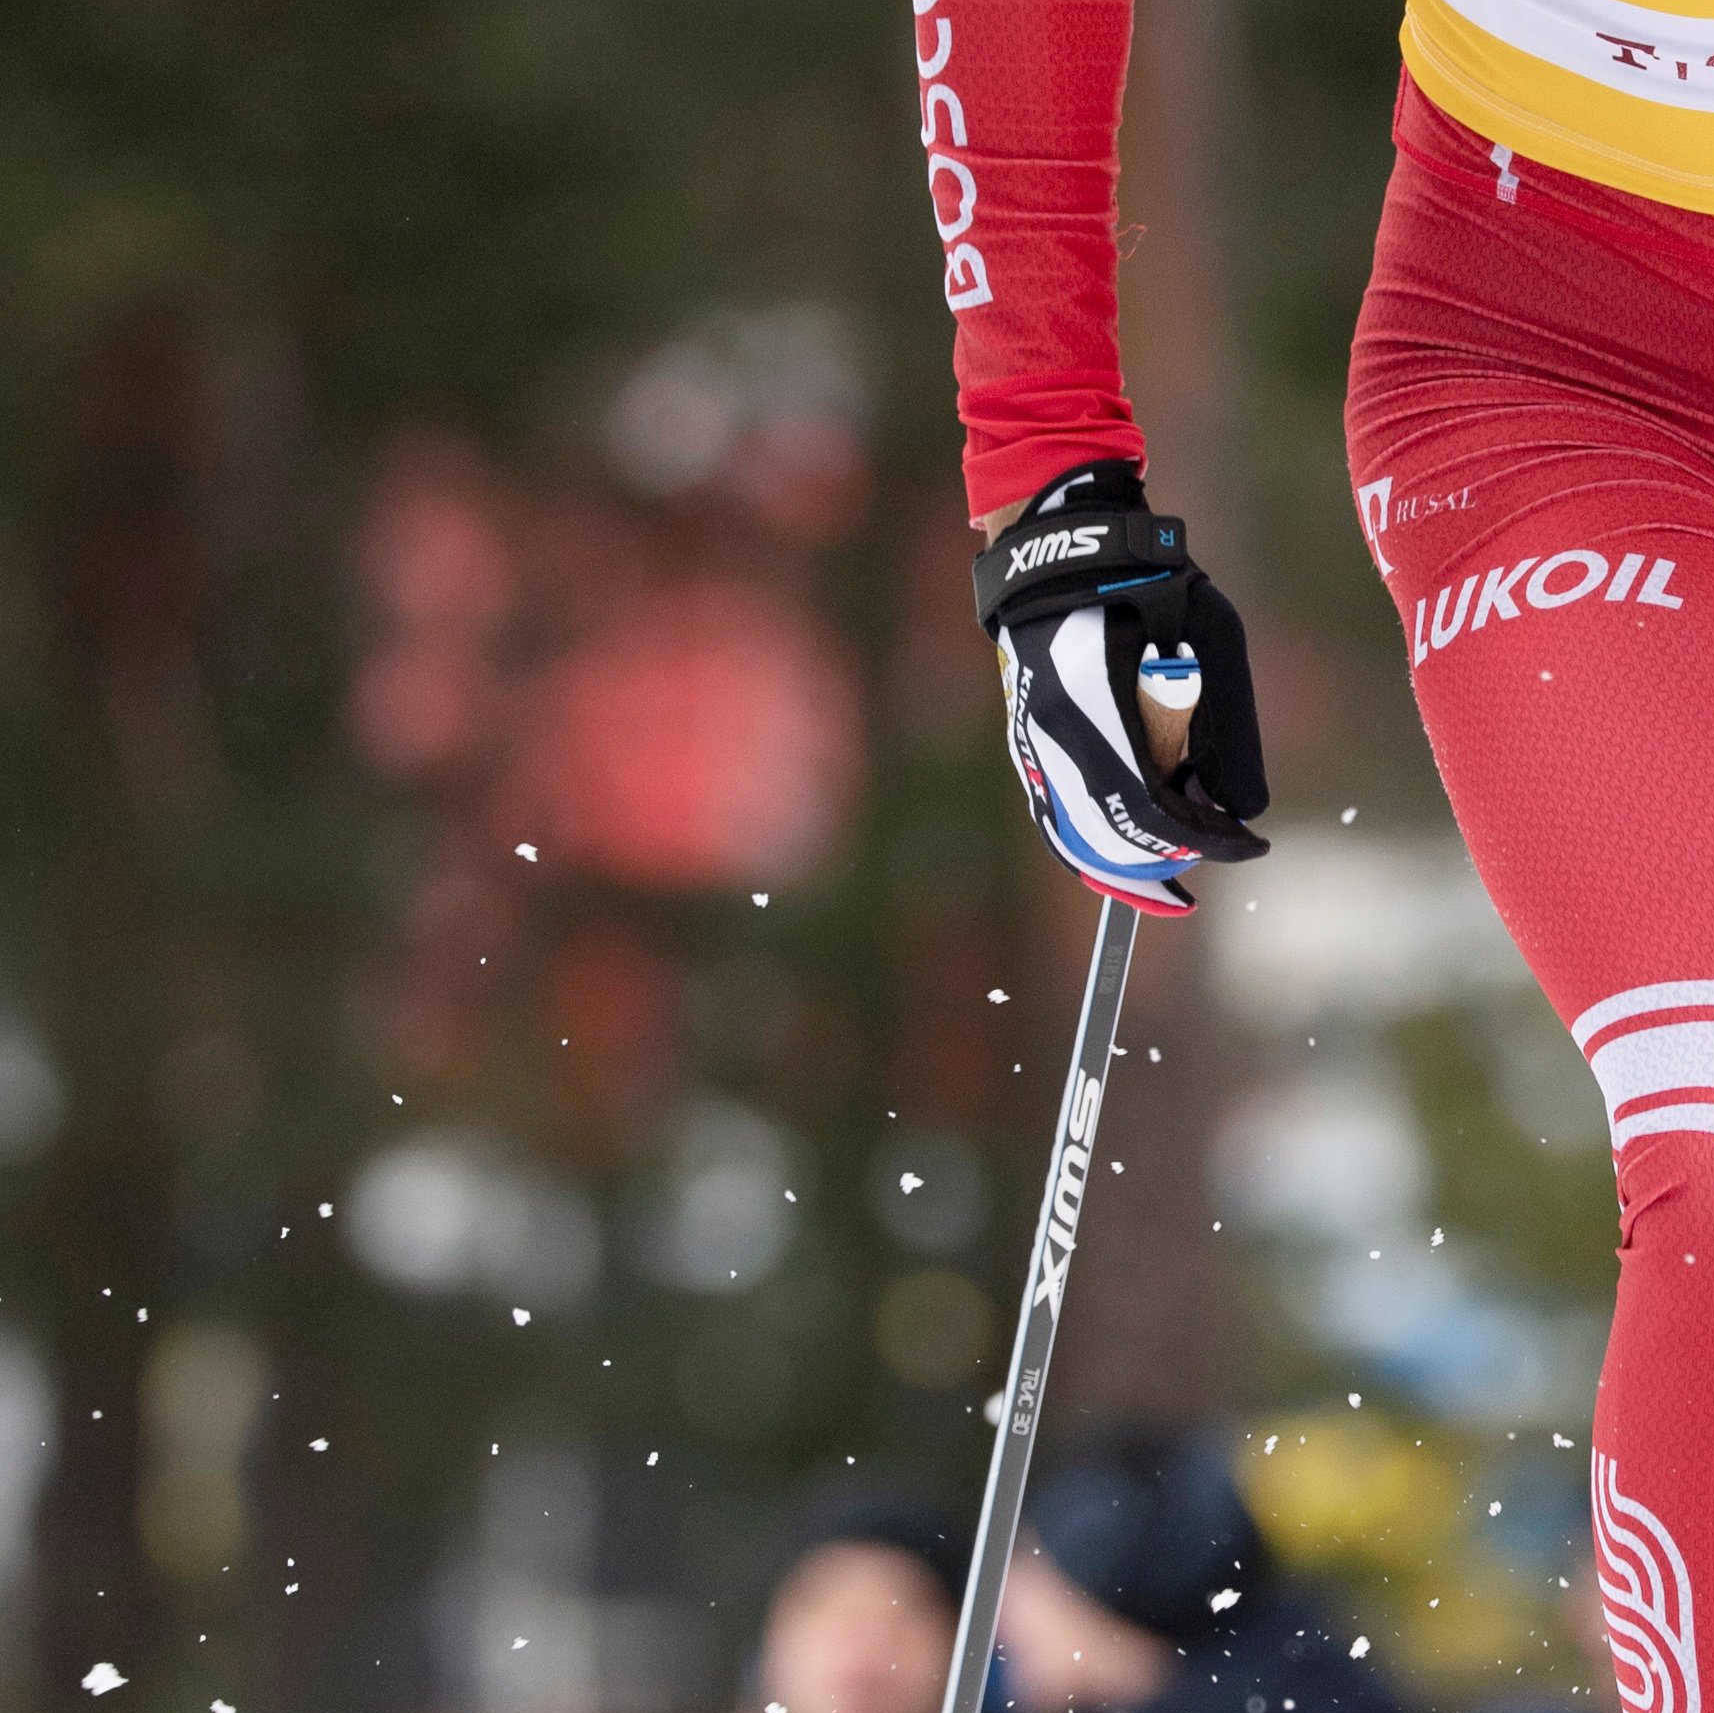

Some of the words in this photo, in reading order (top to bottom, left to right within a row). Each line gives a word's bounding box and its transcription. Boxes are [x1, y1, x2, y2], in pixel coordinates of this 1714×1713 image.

[1004, 525, 1109, 582] SWIX
[1414, 549, 1685, 669] LUKOIL
[1032, 1067, 1101, 1324] SWIX
